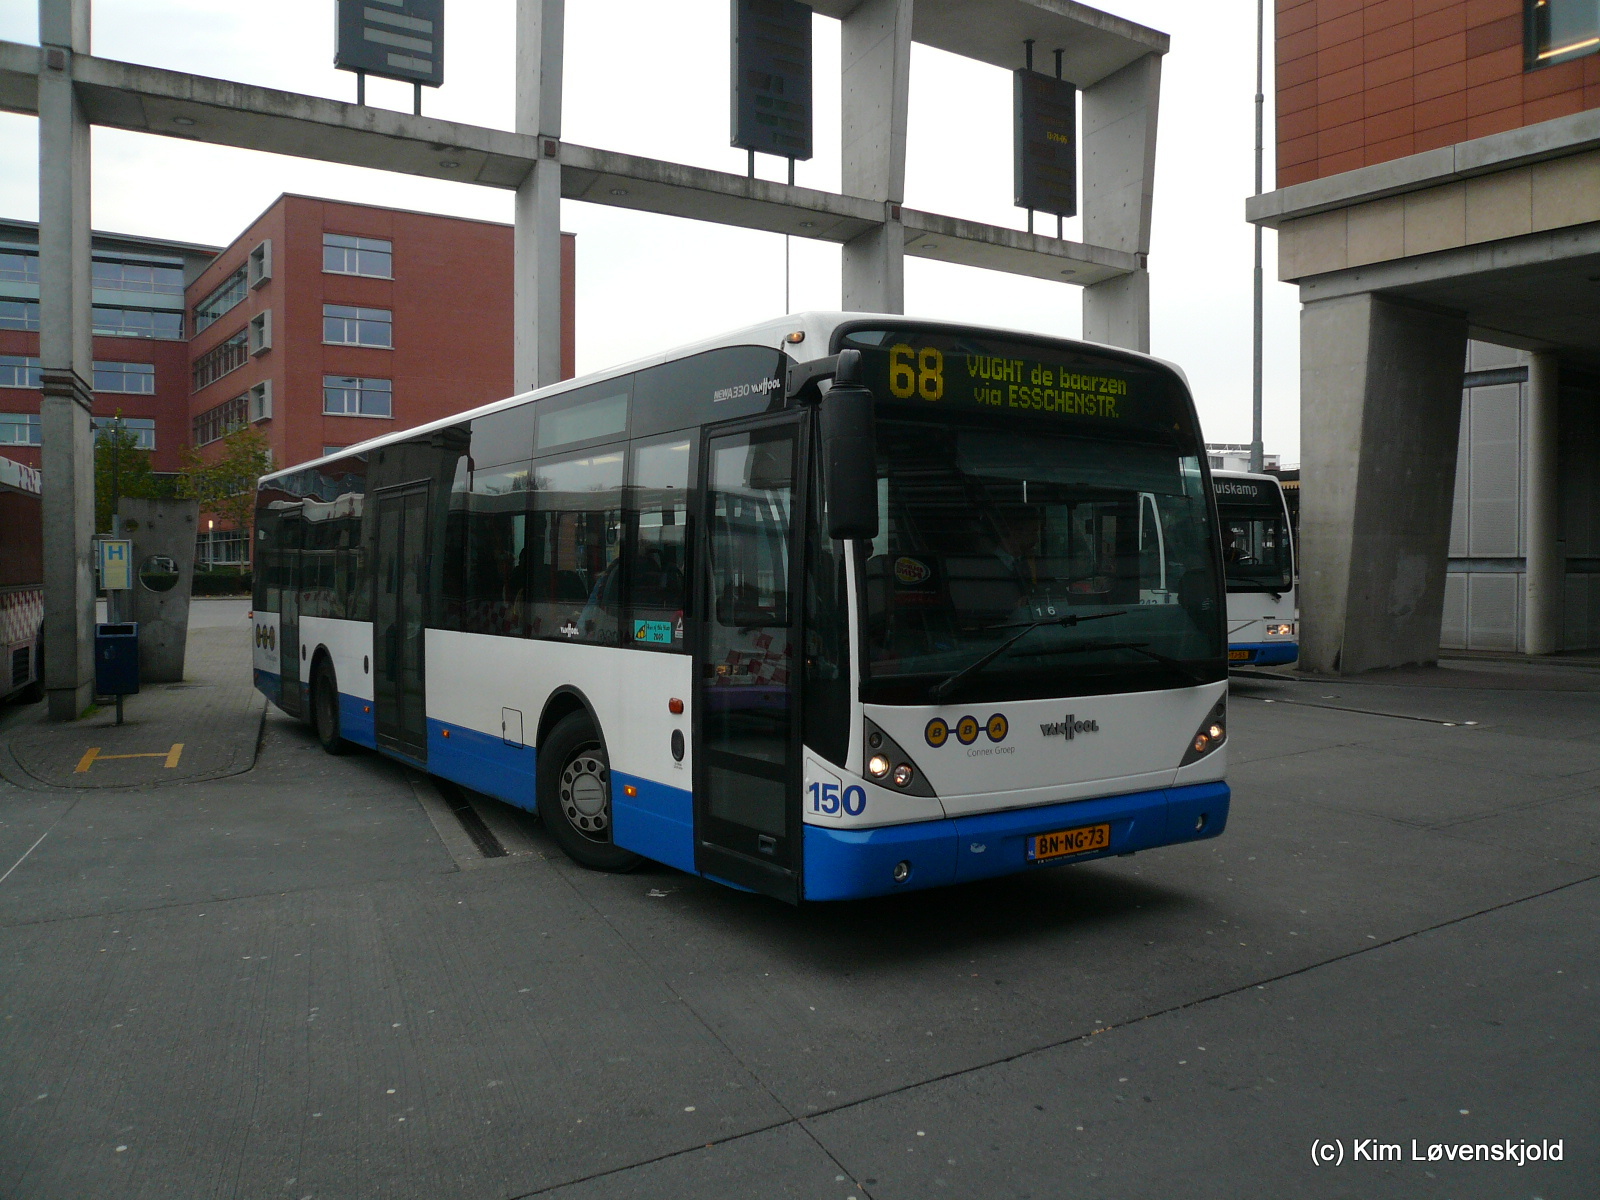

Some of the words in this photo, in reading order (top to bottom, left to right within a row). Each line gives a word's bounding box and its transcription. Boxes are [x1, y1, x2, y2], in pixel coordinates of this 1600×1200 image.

[889, 343, 944, 401] 68
[966, 353, 1024, 383] VUGHT
[1030, 363, 1053, 387] de
[1059, 366, 1127, 395] baarzen
[973, 382, 1001, 406] via
[1008, 385, 1120, 418] ESSCHENSTR.
[1213, 483, 1258, 497] uiskamp
[108, 545, 123, 560] H
[967, 748, 993, 757] Connex
[995, 746, 1015, 755] Groep
[808, 782, 867, 816] 150
[1039, 829, 1104, 854] BN-NG-73
